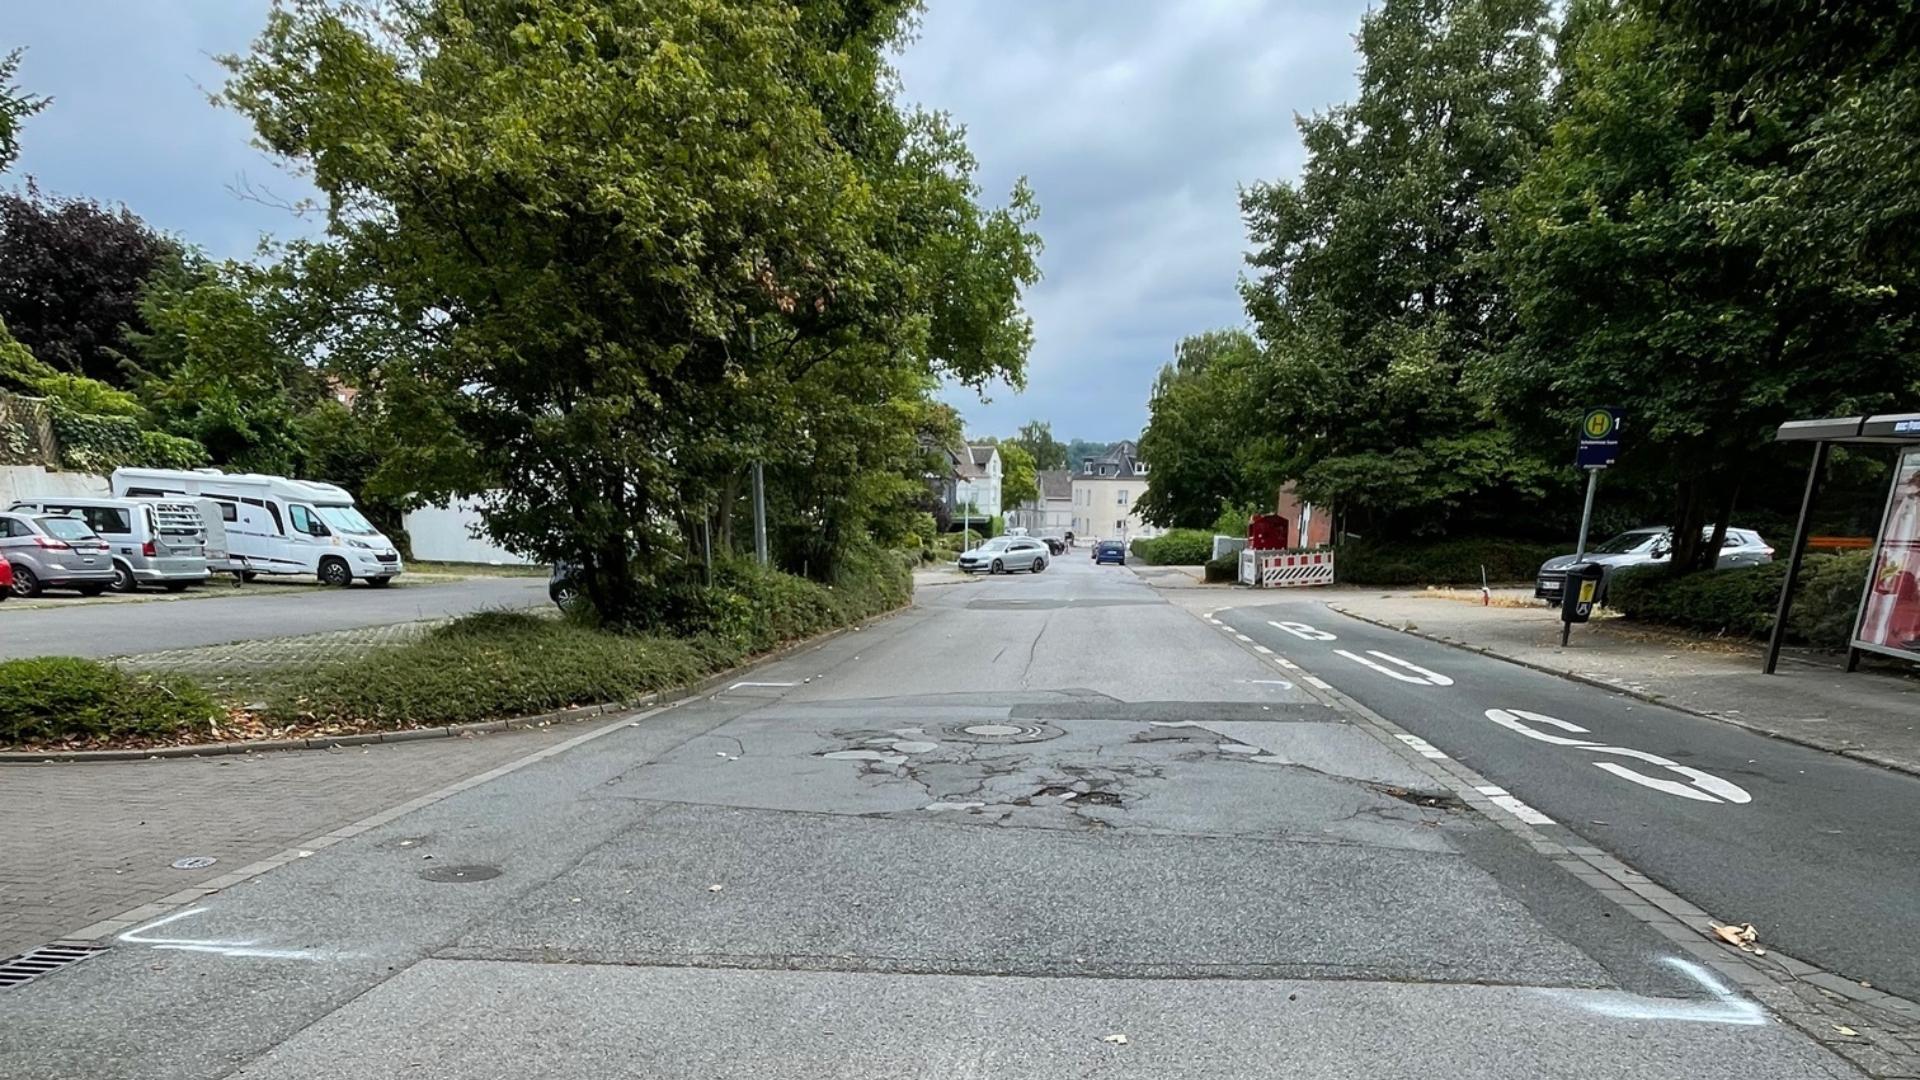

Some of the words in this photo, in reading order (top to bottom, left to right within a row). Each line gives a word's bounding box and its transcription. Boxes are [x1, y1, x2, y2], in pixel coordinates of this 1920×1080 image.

[1592, 416, 1605, 432] H
[1614, 417, 1620, 430] 1
[1268, 620, 1752, 804] BUS
